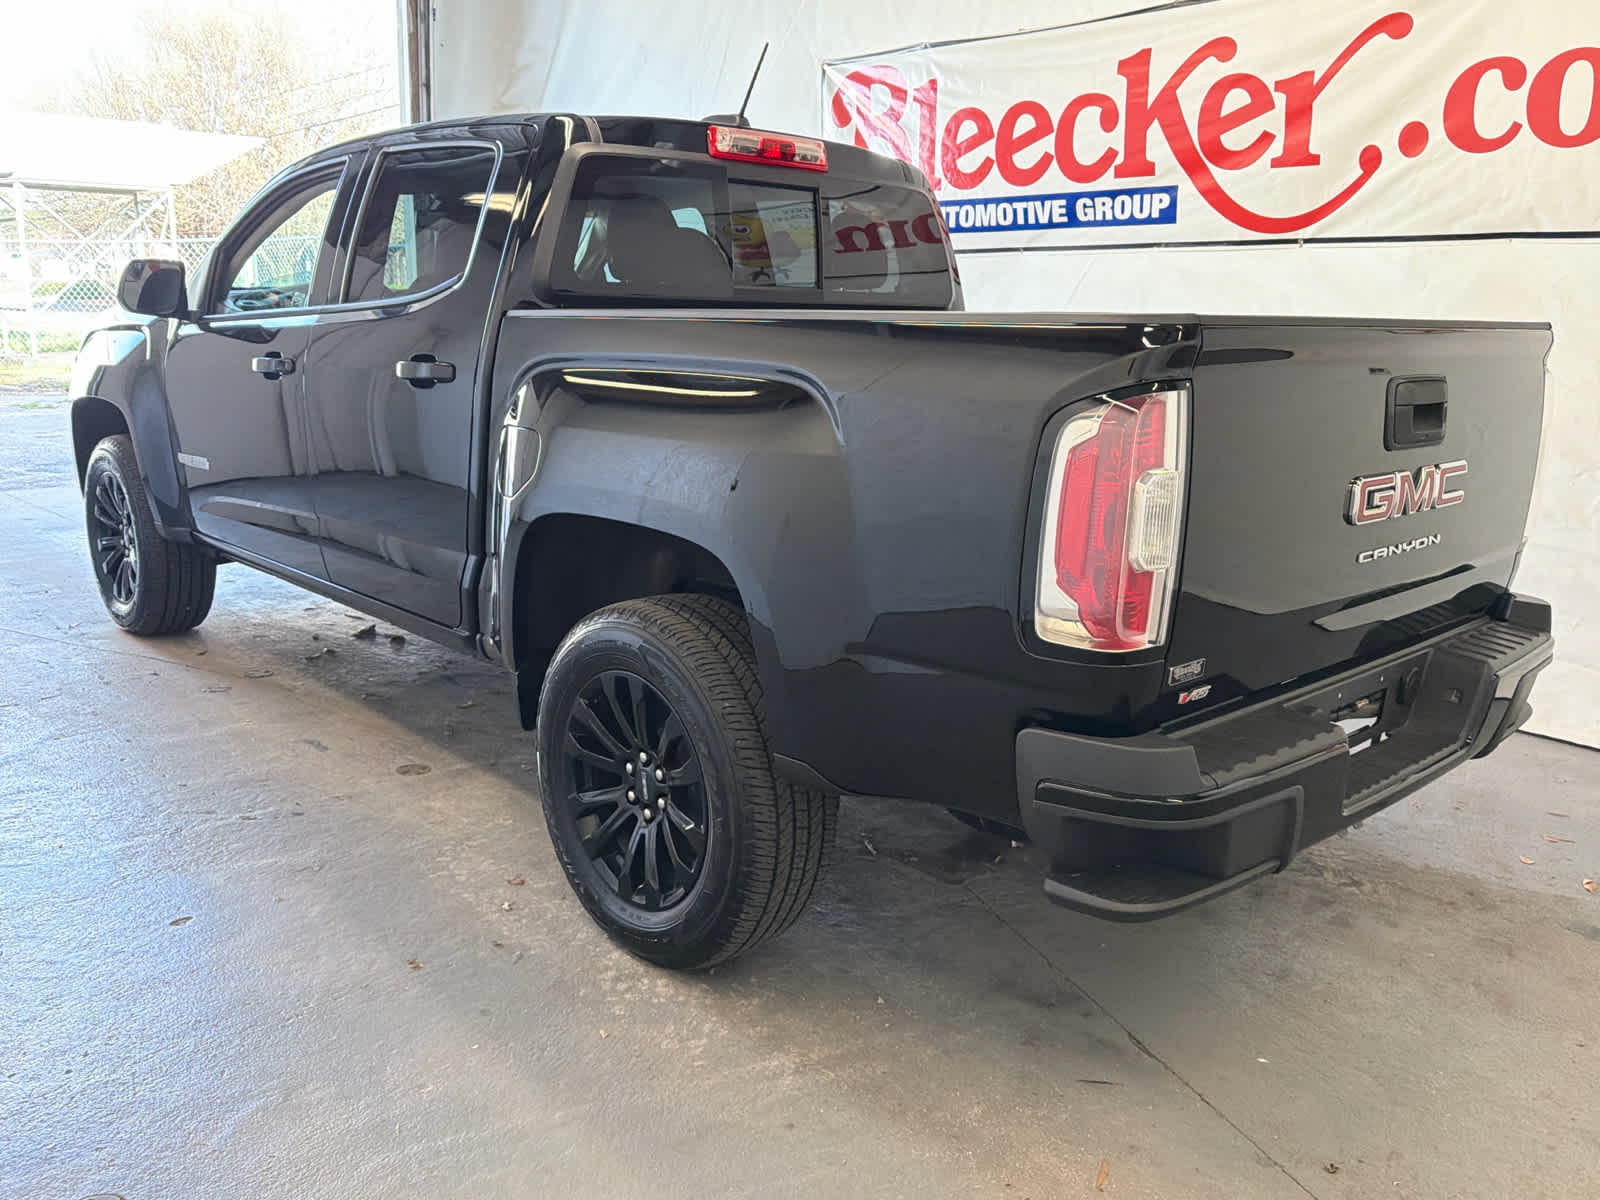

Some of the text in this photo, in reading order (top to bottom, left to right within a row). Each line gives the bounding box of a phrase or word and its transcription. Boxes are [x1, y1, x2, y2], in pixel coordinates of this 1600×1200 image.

[940, 193, 1171, 229] TOMOTIVE GROUP
[1344, 459, 1468, 525] GMC
[1356, 534, 1441, 563] CANYON
